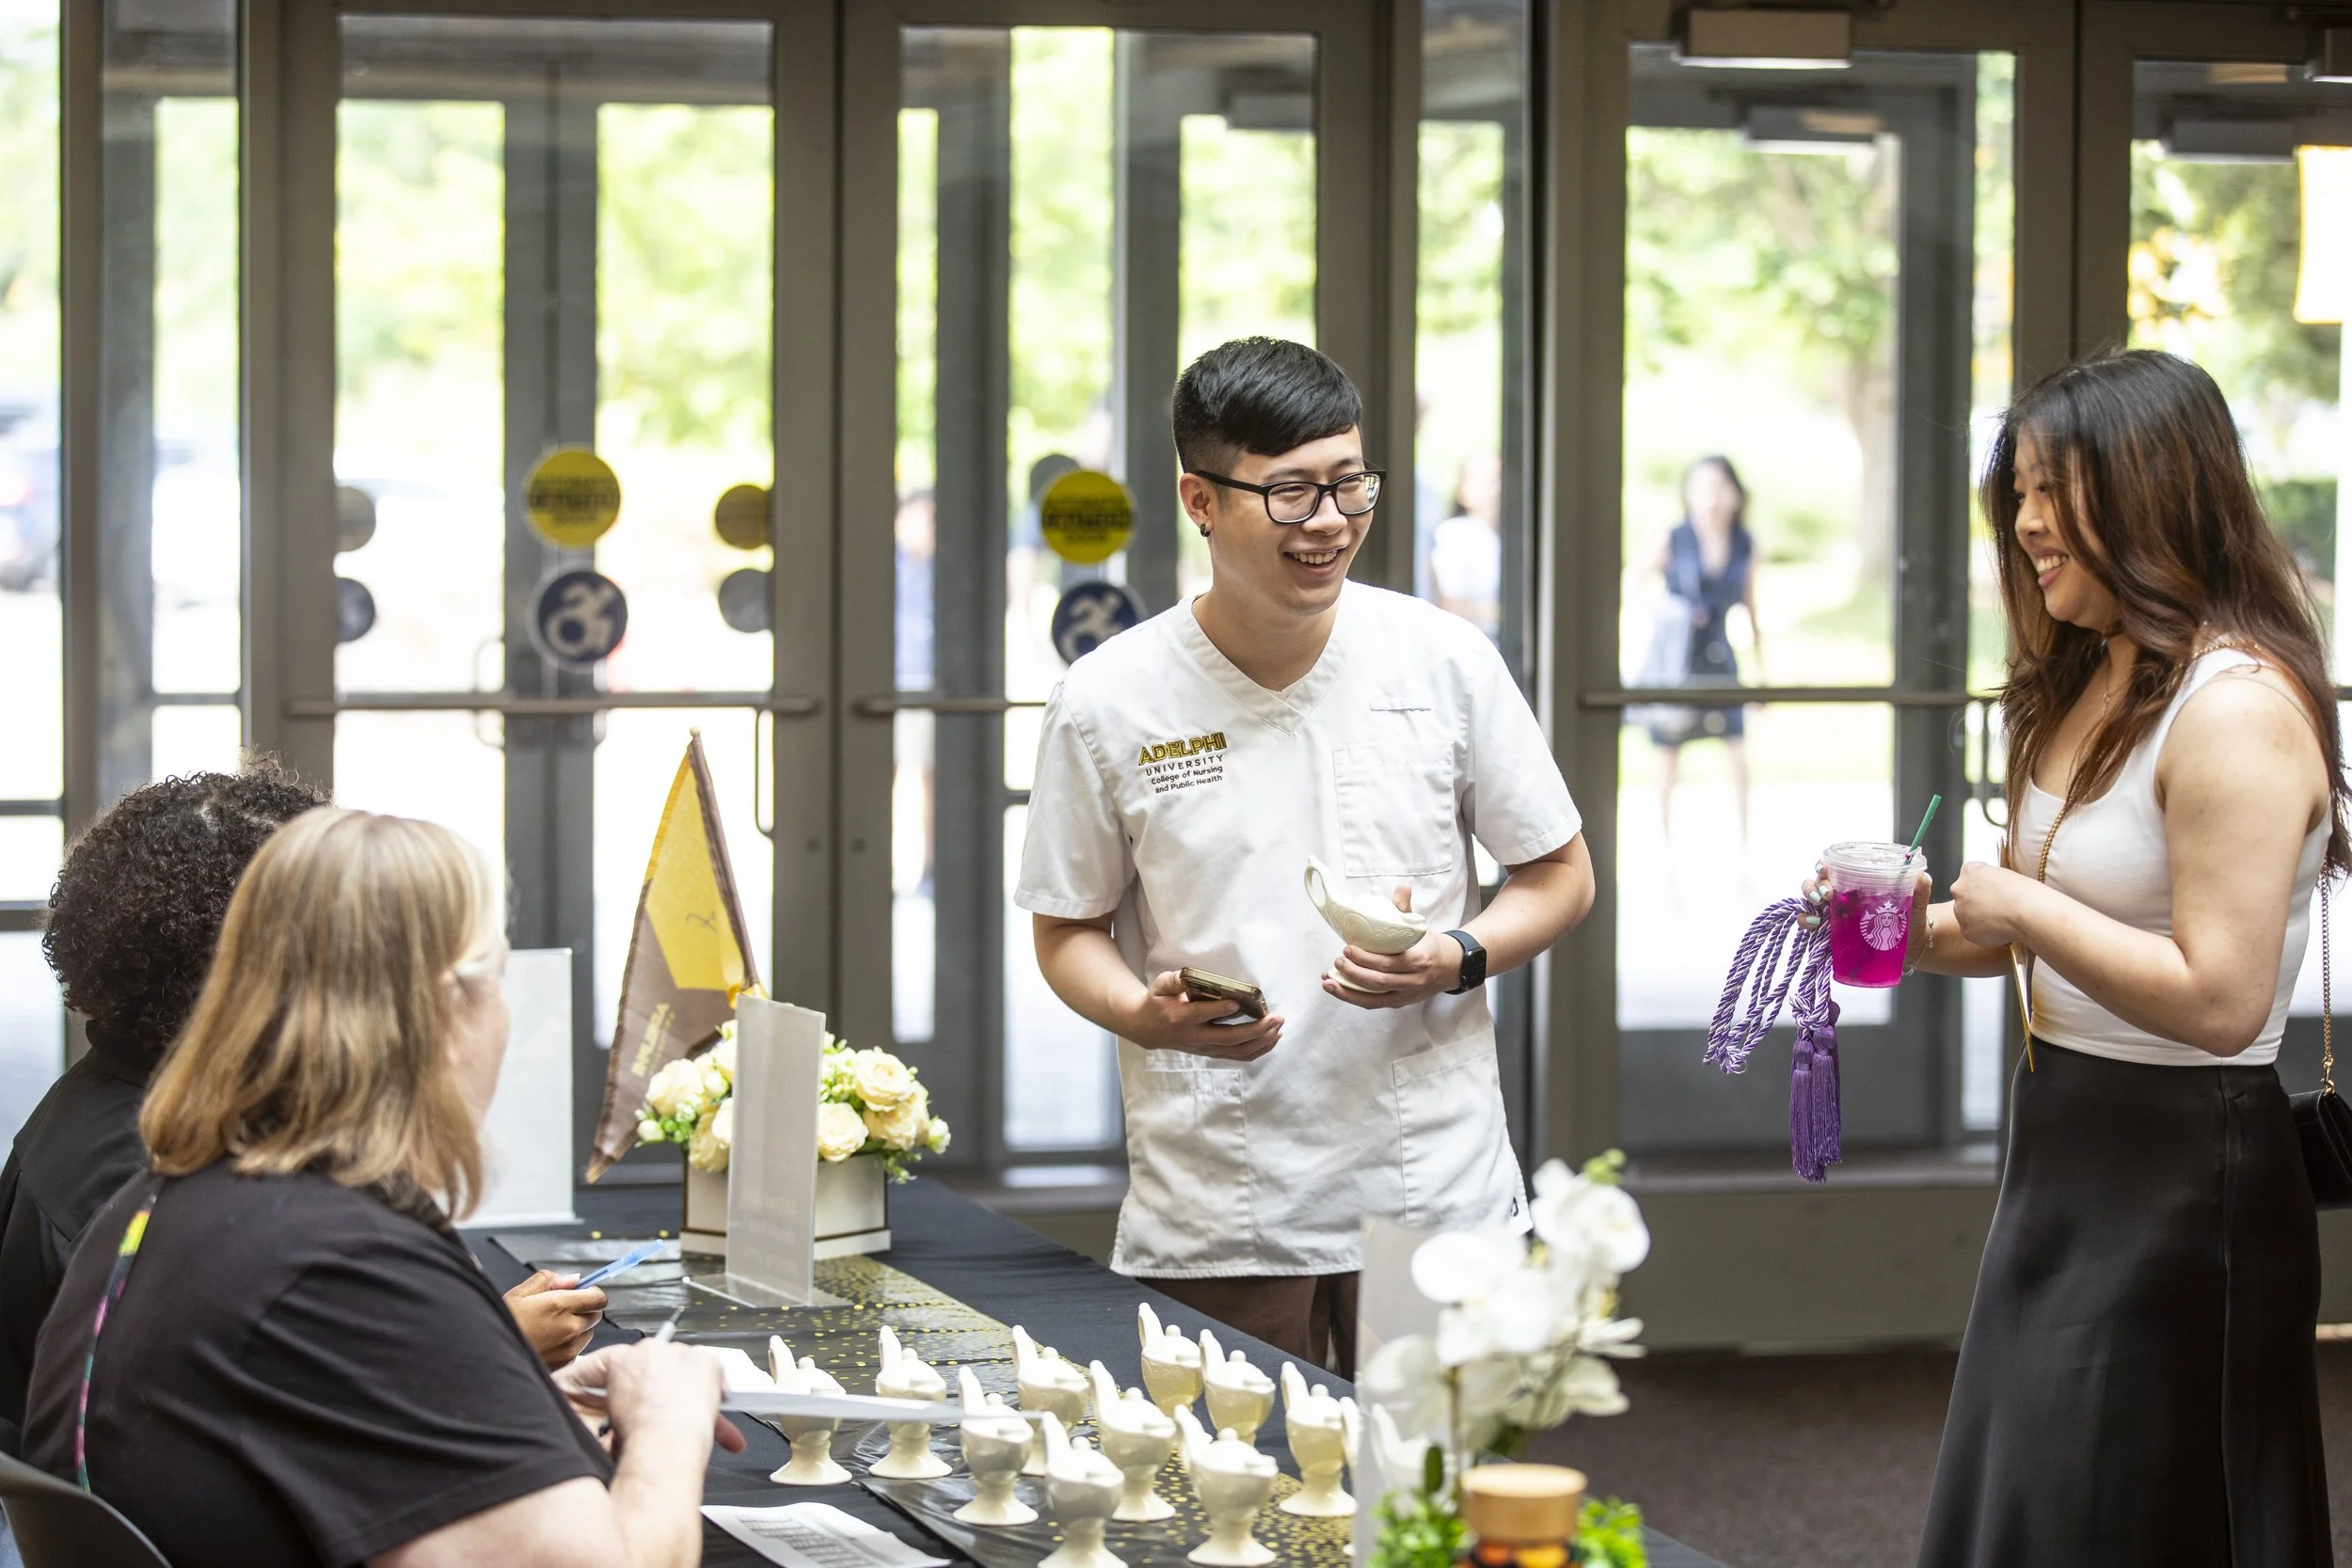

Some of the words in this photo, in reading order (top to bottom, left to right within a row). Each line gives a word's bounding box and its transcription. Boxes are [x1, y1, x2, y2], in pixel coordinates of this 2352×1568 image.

[1138, 732, 1227, 766] ADELPHI
[1146, 754, 1223, 777] UNIVERSITY
[1151, 773, 1180, 785] College
[1182, 769, 1191, 779] of
[1193, 766, 1223, 776] Nursing
[1154, 784, 1169, 794] and
[1170, 780, 1195, 790] Public
[1197, 775, 1223, 785] Health
